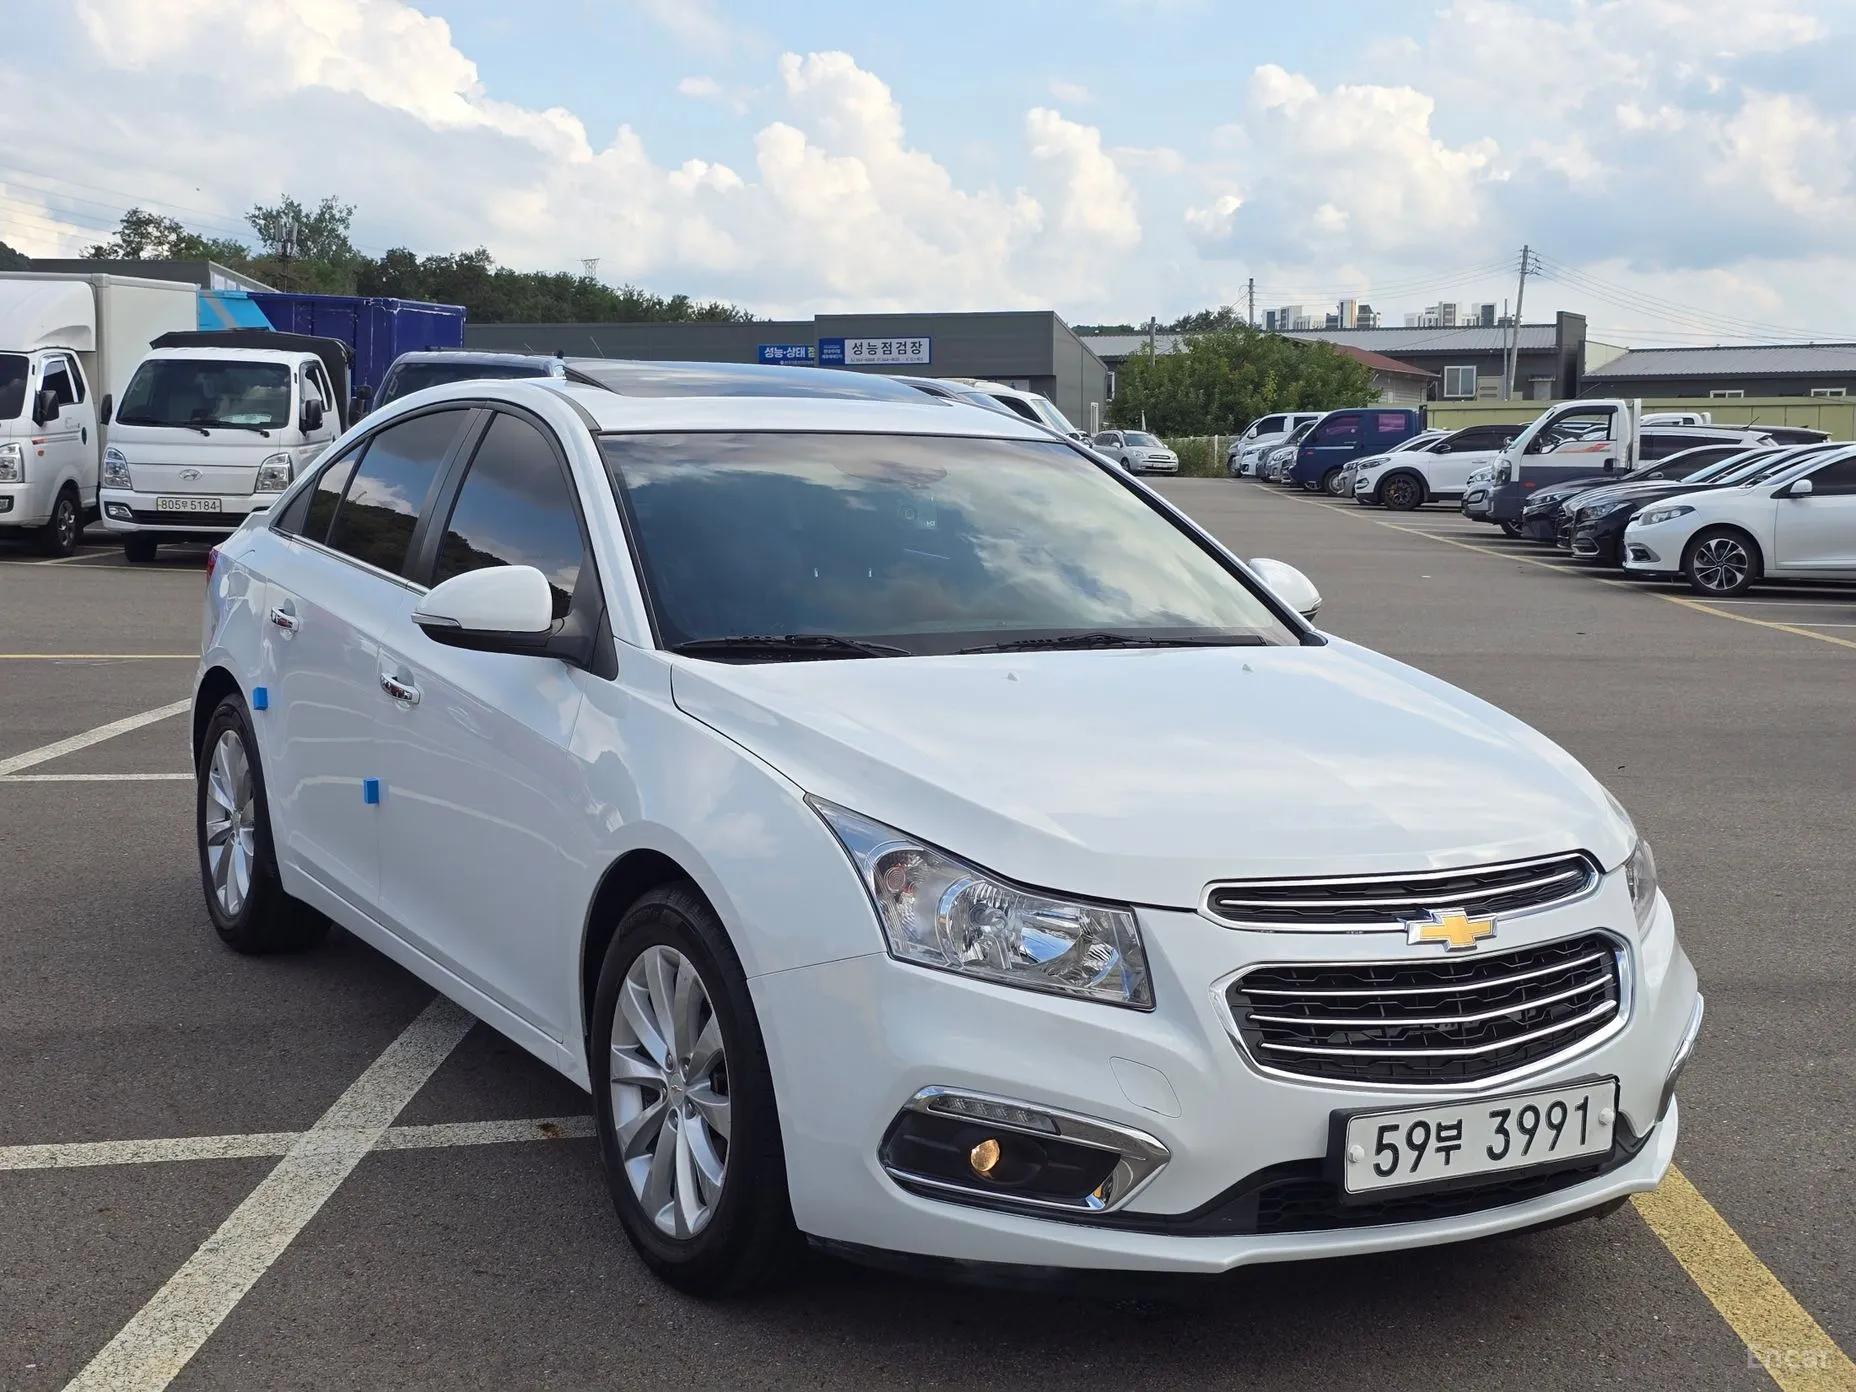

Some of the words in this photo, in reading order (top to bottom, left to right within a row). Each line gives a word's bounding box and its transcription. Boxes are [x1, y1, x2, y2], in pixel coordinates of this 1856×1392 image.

[852, 341, 923, 356] 성능점검장
[190, 500, 217, 510] 5184
[1372, 1118, 1464, 1178] 59부
[1486, 1094, 1590, 1162] 3991
